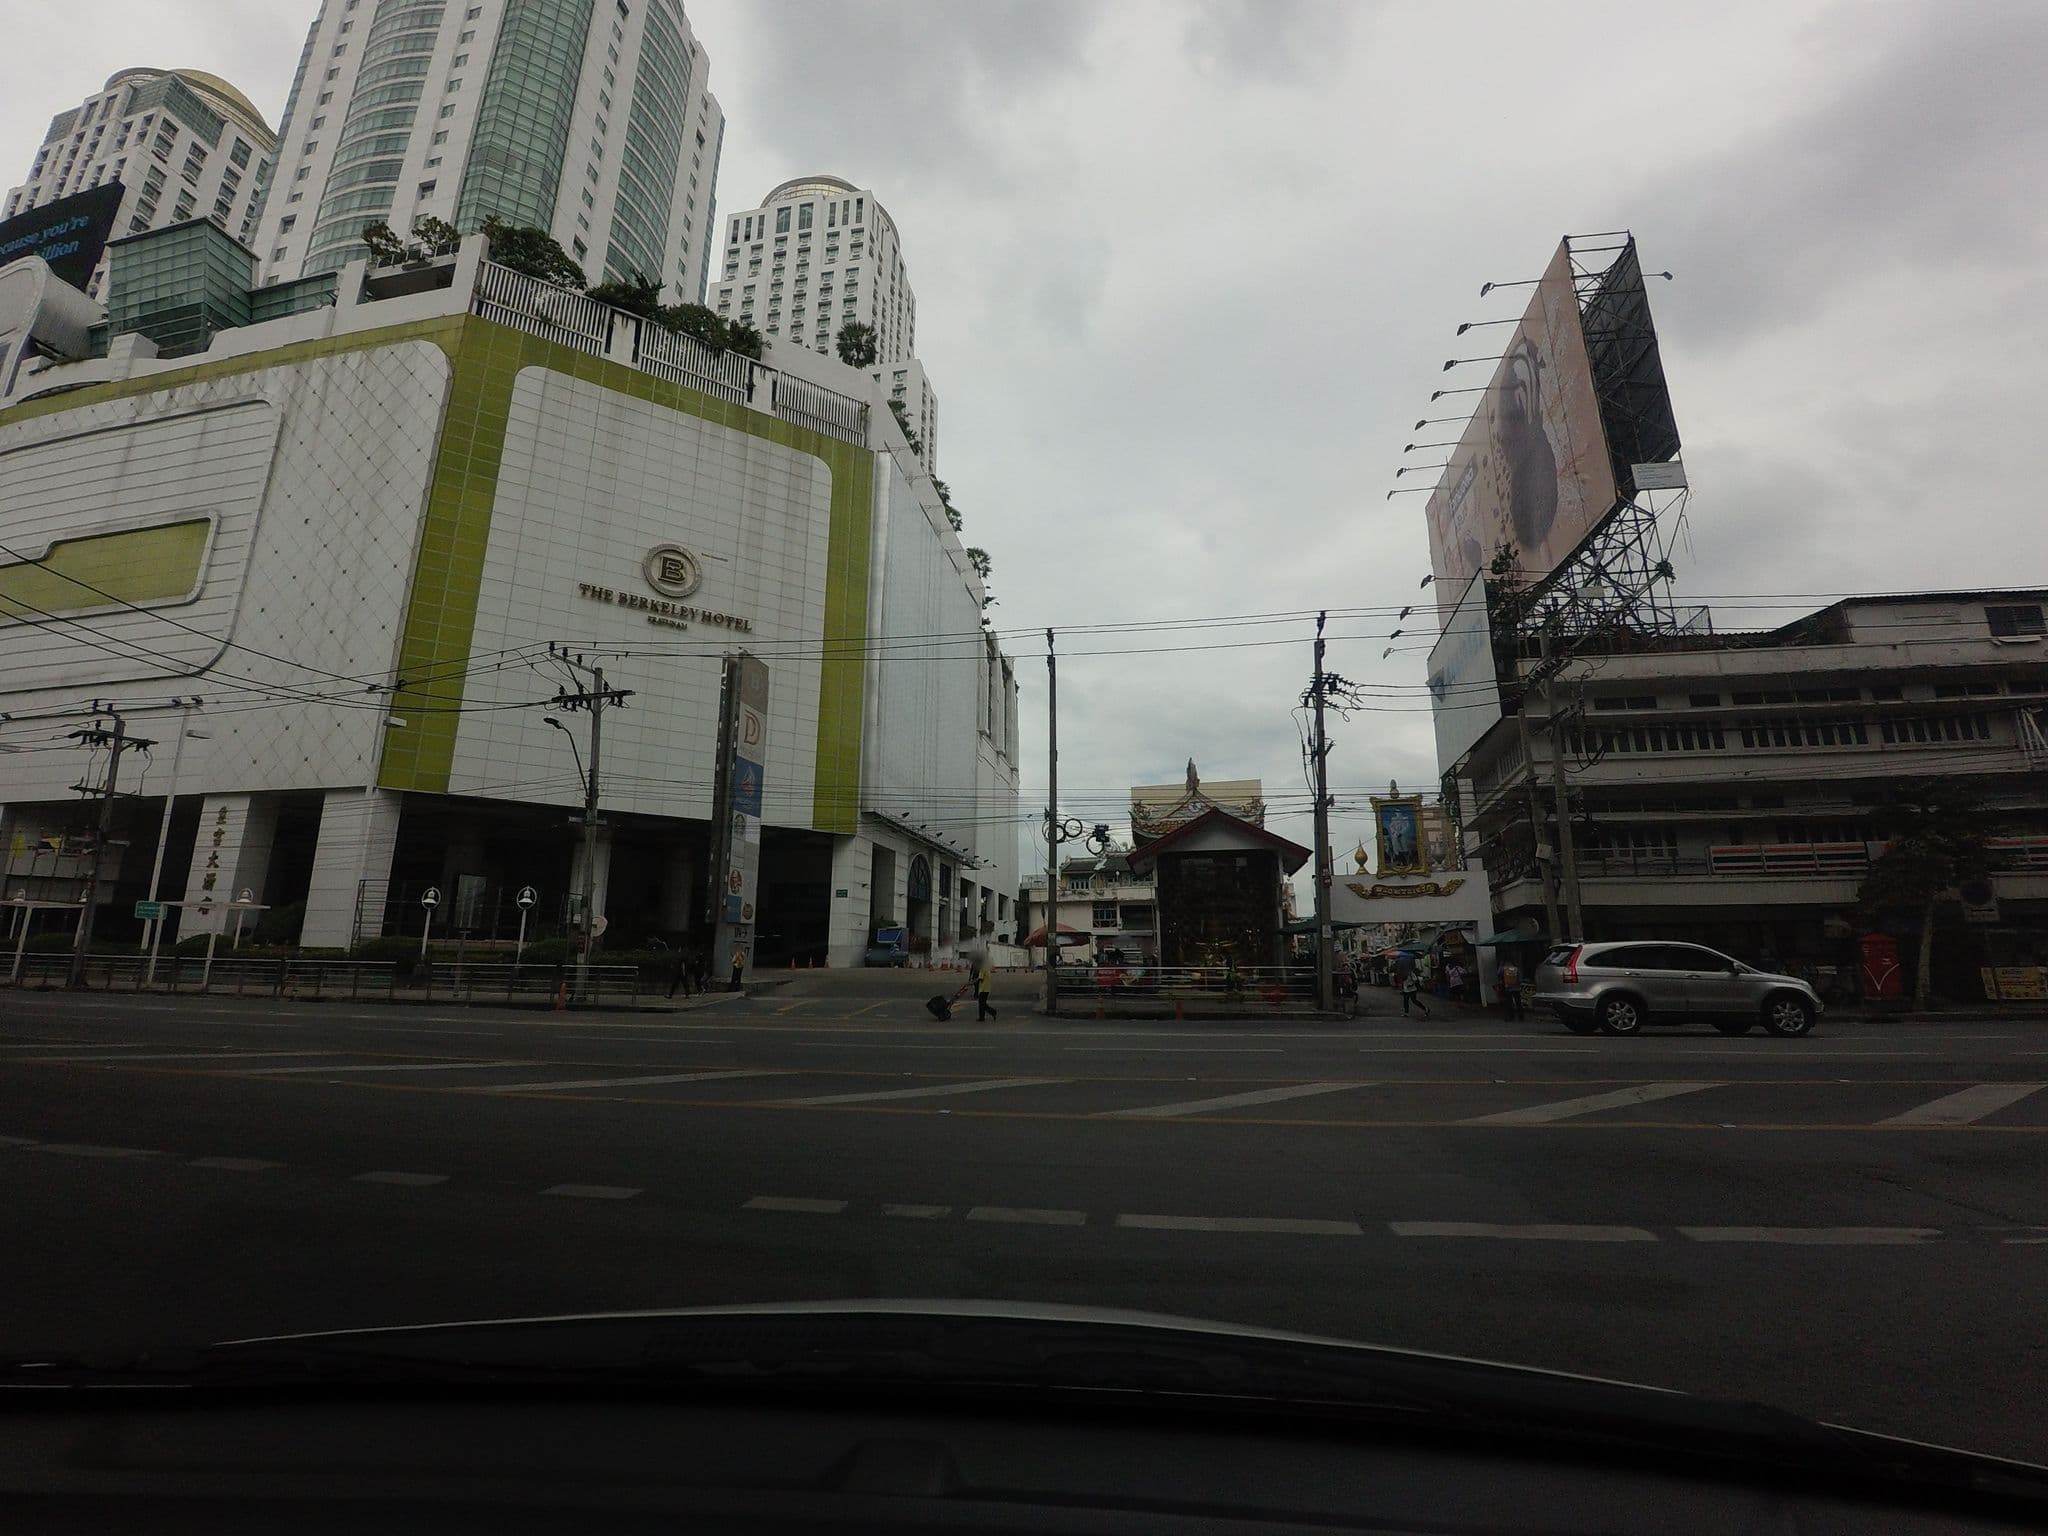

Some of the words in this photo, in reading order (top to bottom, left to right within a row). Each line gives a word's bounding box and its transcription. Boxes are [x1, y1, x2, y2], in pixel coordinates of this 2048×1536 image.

[43, 216, 89, 238] you're
[579, 583, 613, 601] THE
[618, 592, 698, 619] BERKELEY
[701, 610, 752, 632] HOTEL
